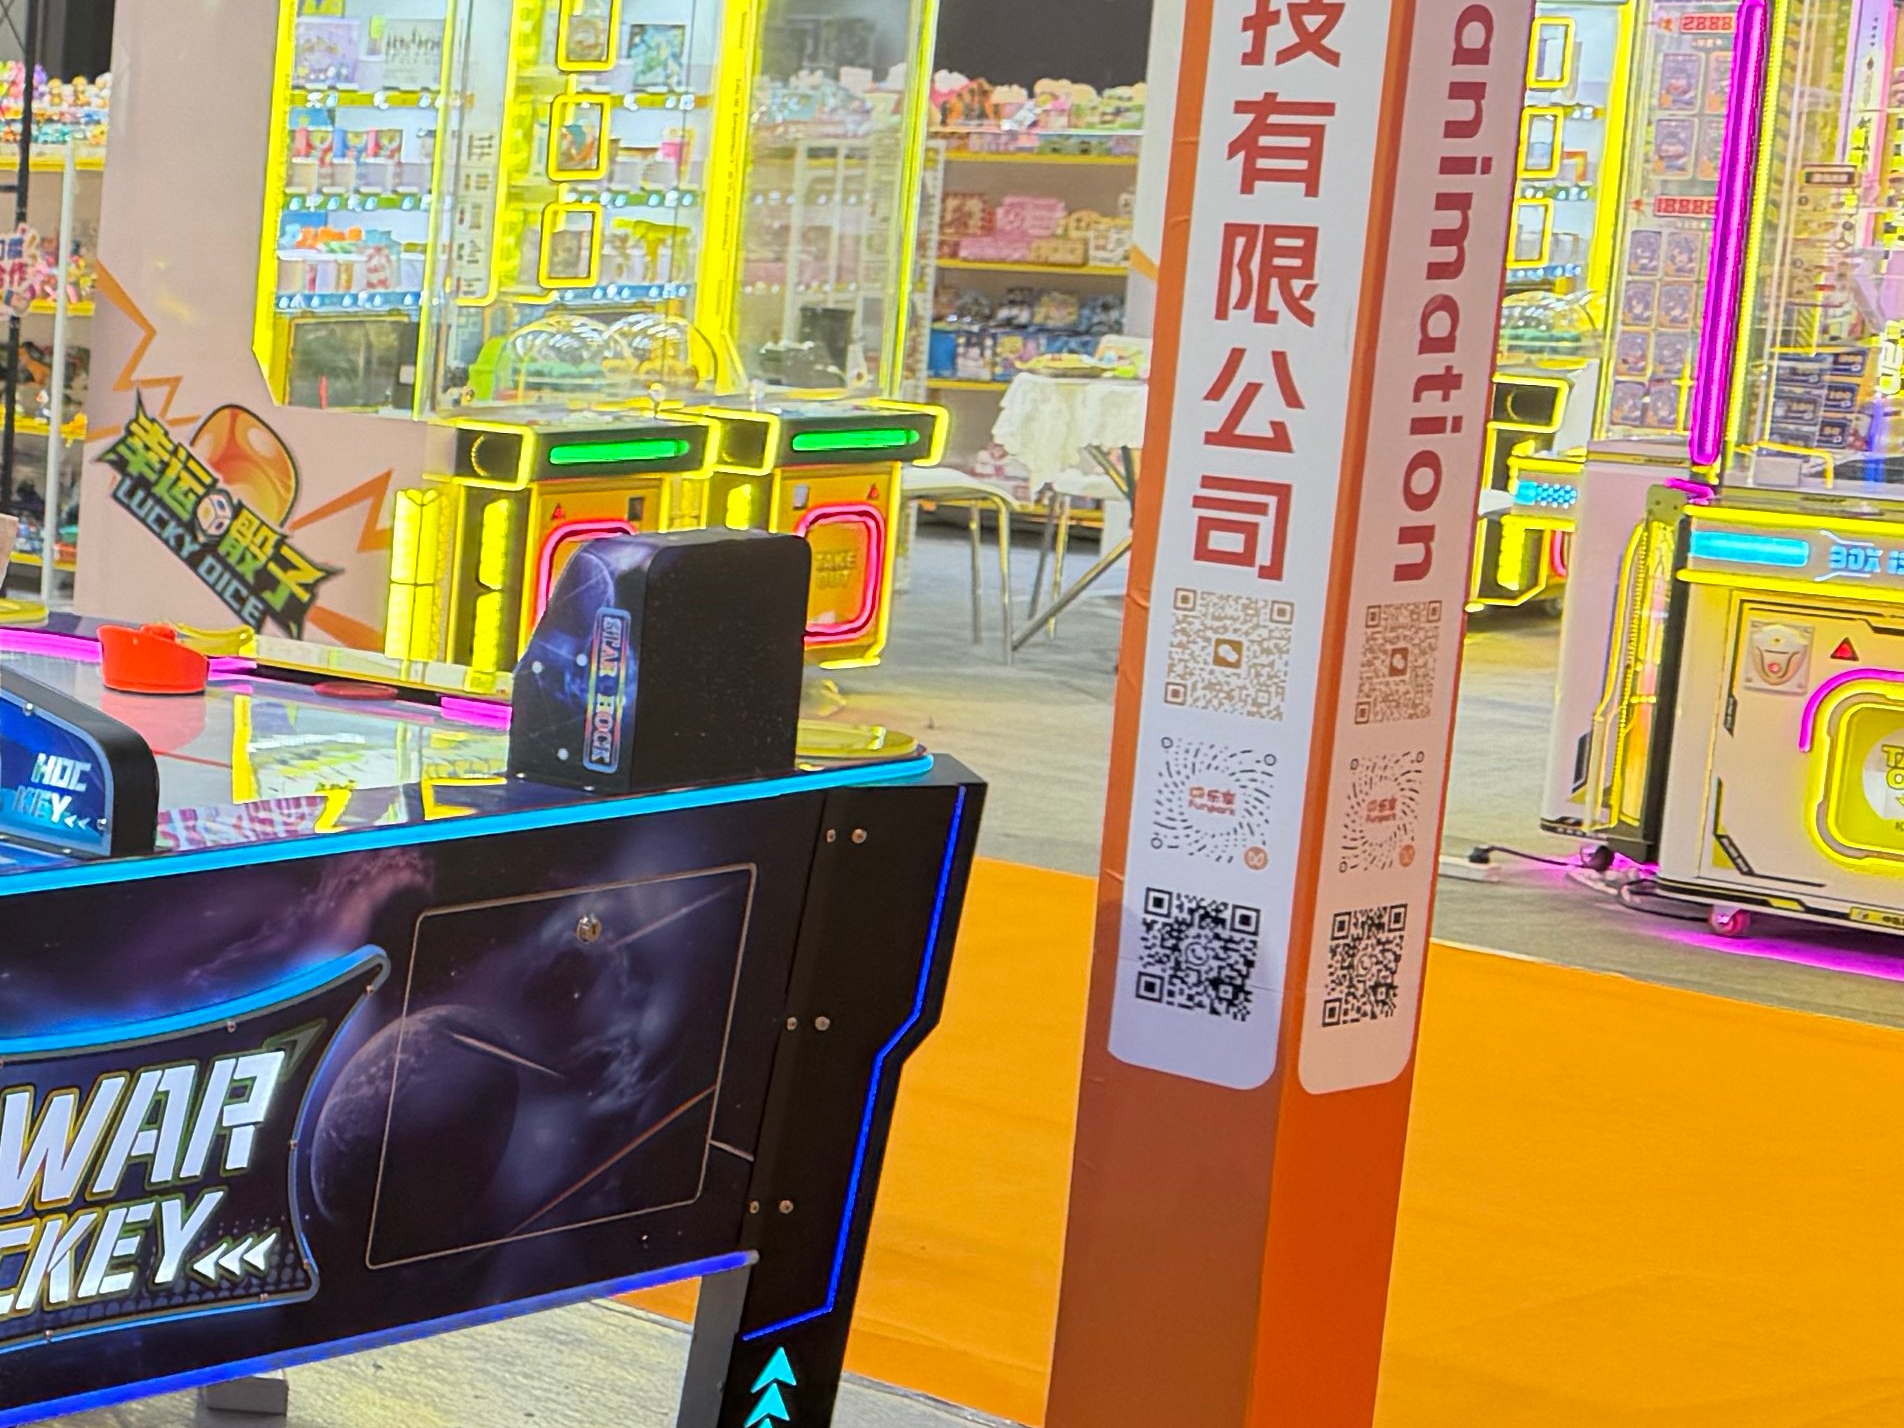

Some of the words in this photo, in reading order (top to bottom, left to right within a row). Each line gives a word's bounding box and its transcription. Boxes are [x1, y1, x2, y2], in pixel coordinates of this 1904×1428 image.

[1391, 3, 1495, 583] animation
[114, 476, 198, 559] LUCKY
[198, 553, 268, 628] DICE
[30, 752, 92, 793] HOC
